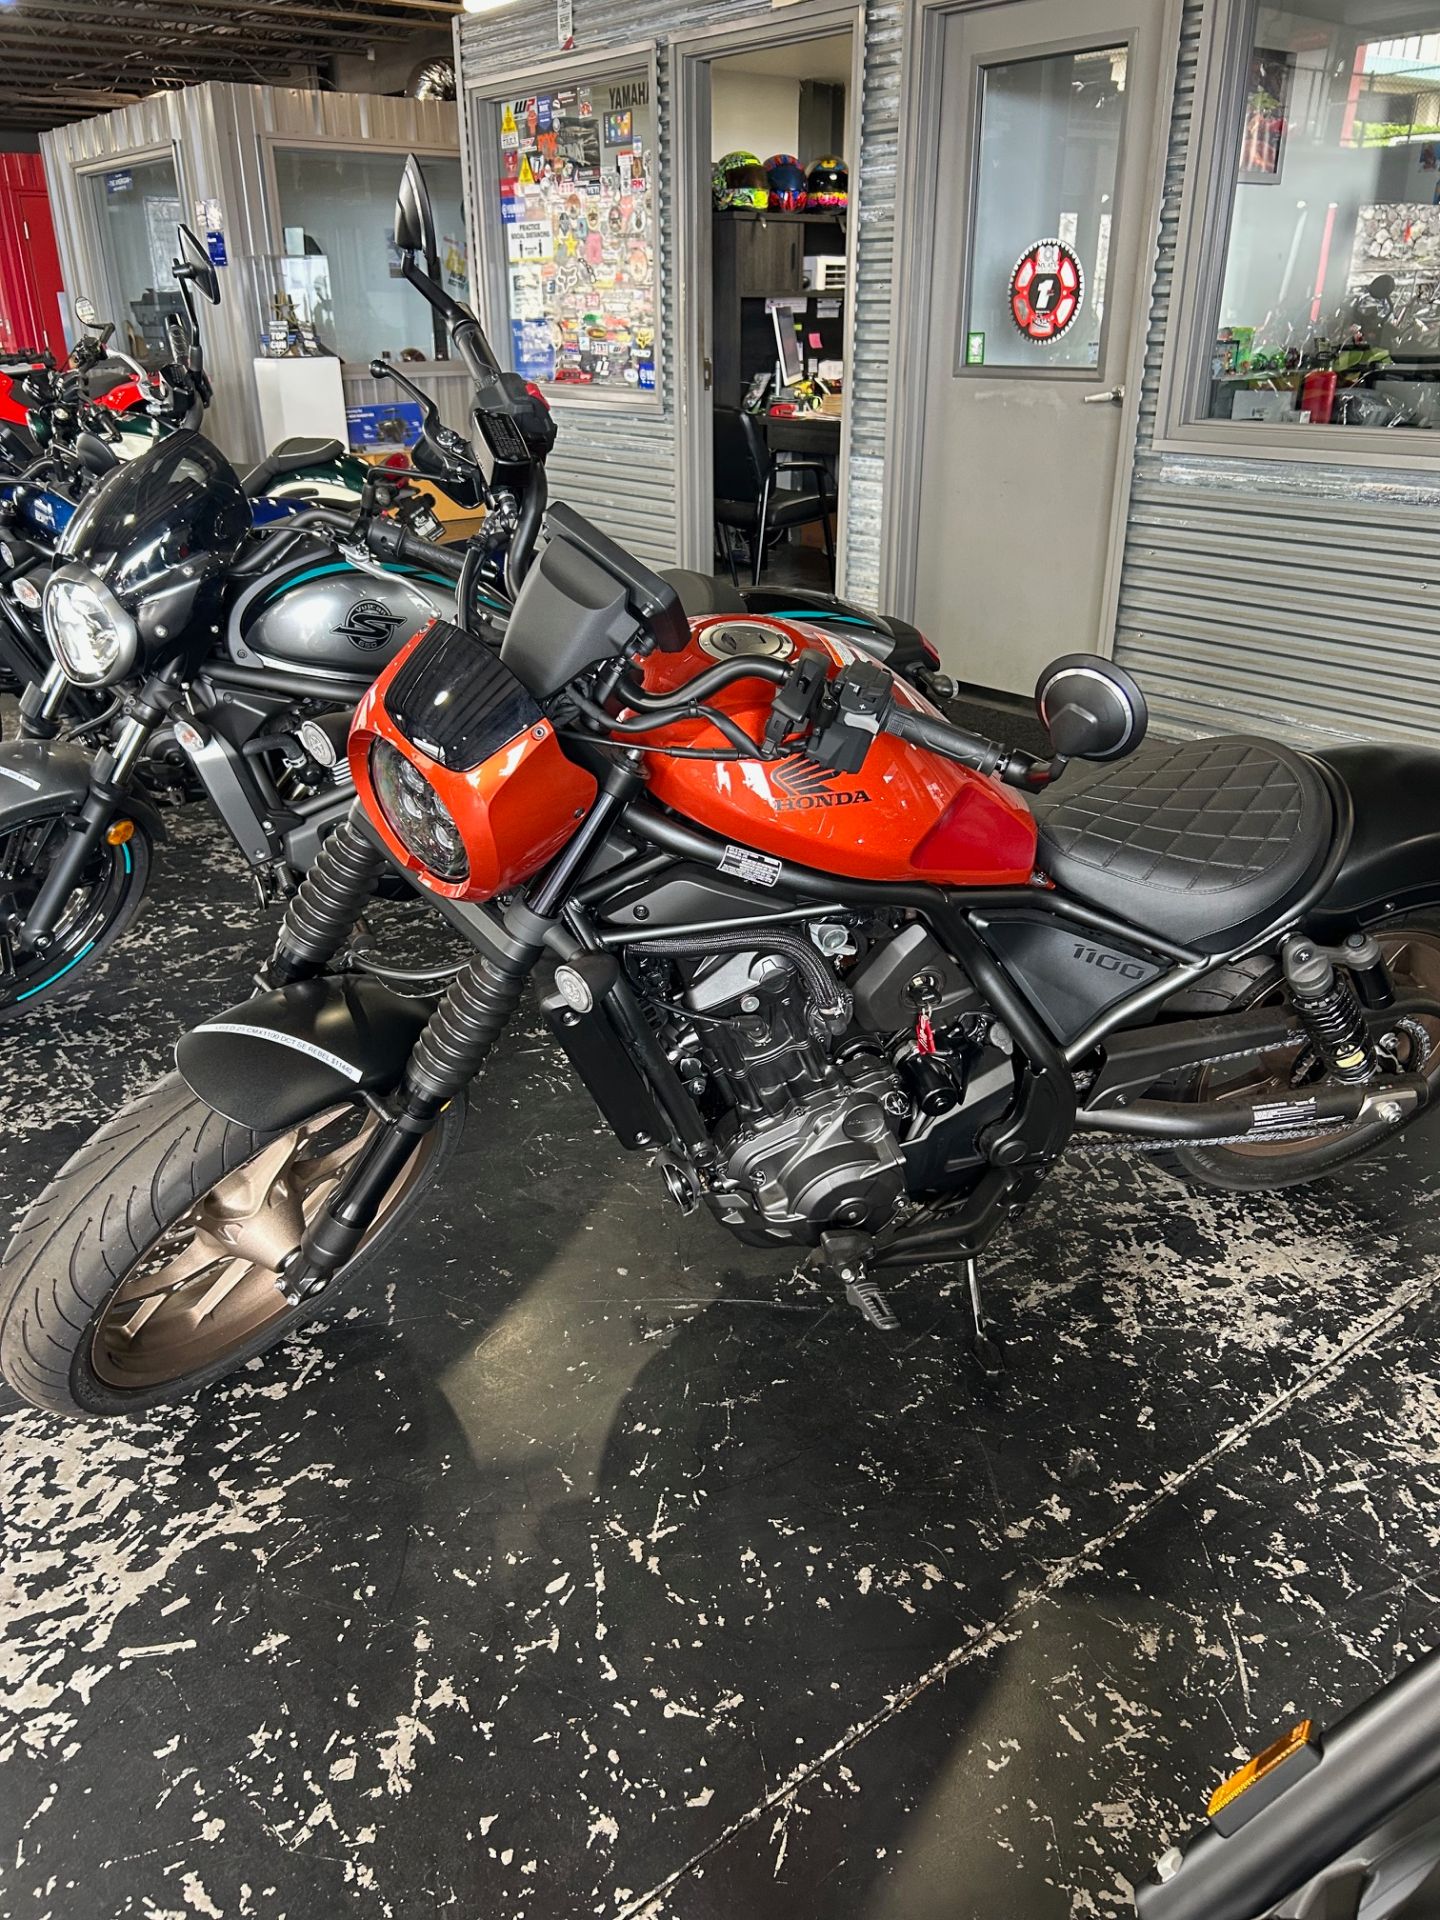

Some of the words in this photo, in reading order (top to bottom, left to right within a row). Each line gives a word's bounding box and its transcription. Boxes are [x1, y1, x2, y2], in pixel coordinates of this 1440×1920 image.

[270, 331, 287, 341] TOP
[775, 789, 872, 812] HONDA
[1073, 943, 1146, 980] 1100
[307, 1045, 331, 1062] REBEL
